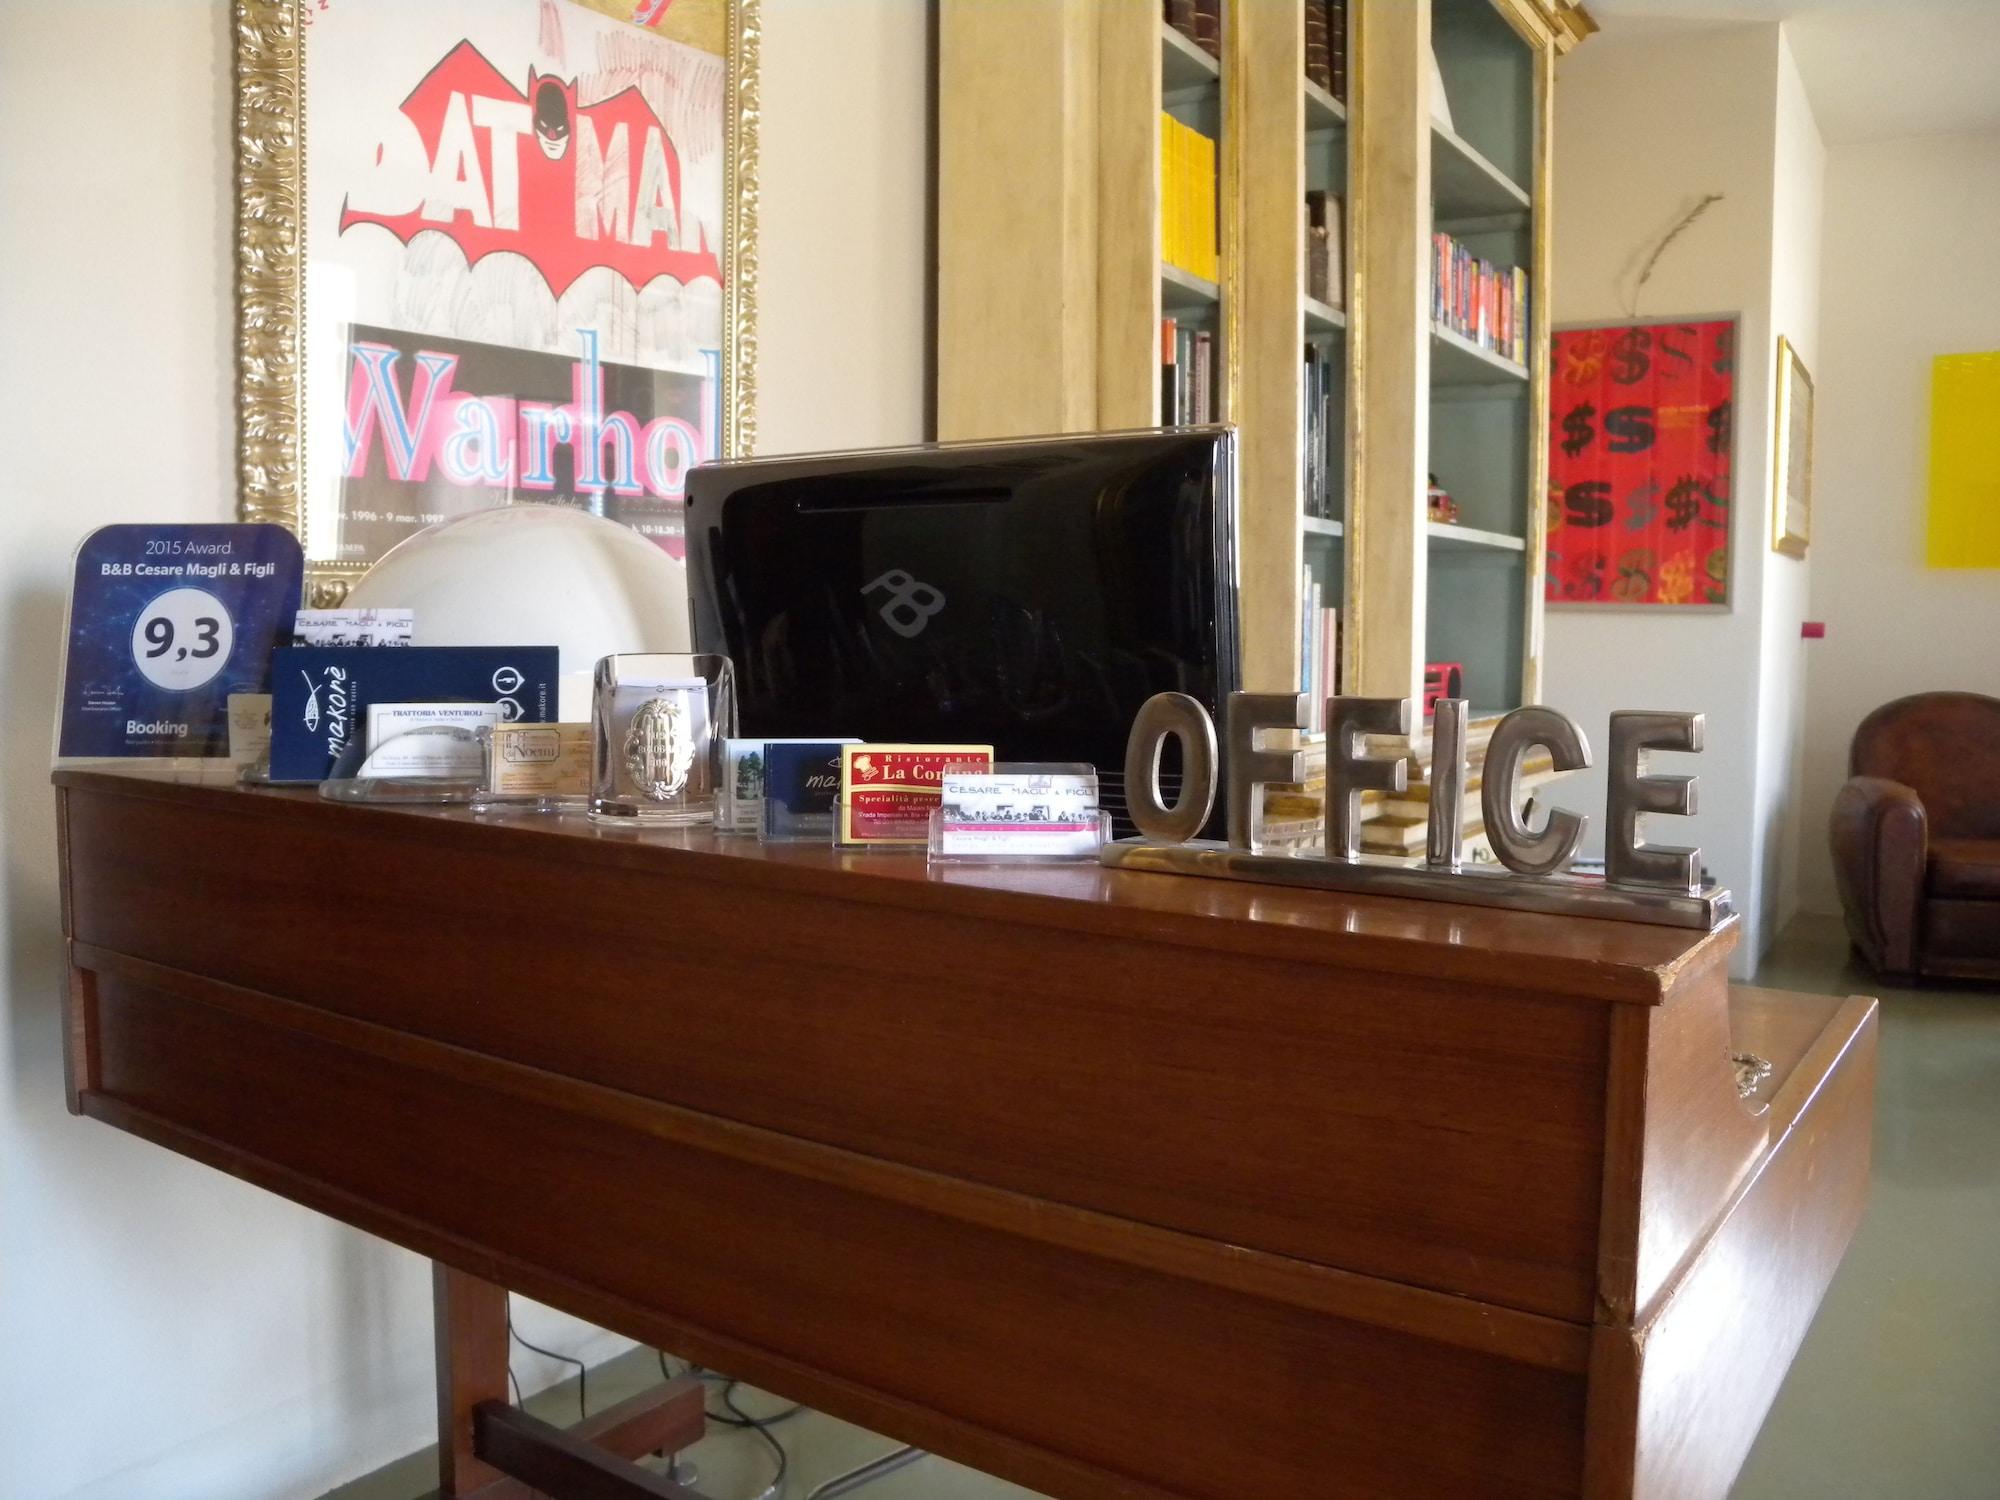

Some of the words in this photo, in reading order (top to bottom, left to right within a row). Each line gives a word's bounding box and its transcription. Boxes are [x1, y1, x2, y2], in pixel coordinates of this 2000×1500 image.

[342, 328, 722, 502] Warhol
[352, 510, 377, 522] 1996
[146, 541, 181, 555] 2015
[184, 541, 232, 555] Award
[101, 563, 132, 576] B&B
[135, 563, 183, 576] Cesare
[186, 562, 226, 578] Magli
[229, 563, 241, 576] &
[244, 562, 275, 578] Figli
[144, 616, 220, 662] 9,3
[126, 720, 188, 737] Booking
[885, 754, 982, 763] Ristorante
[883, 764, 906, 780] La
[949, 785, 1001, 795] CESARE
[1066, 788, 1095, 797] FIGLI
[1125, 691, 1704, 897] OFFICE
